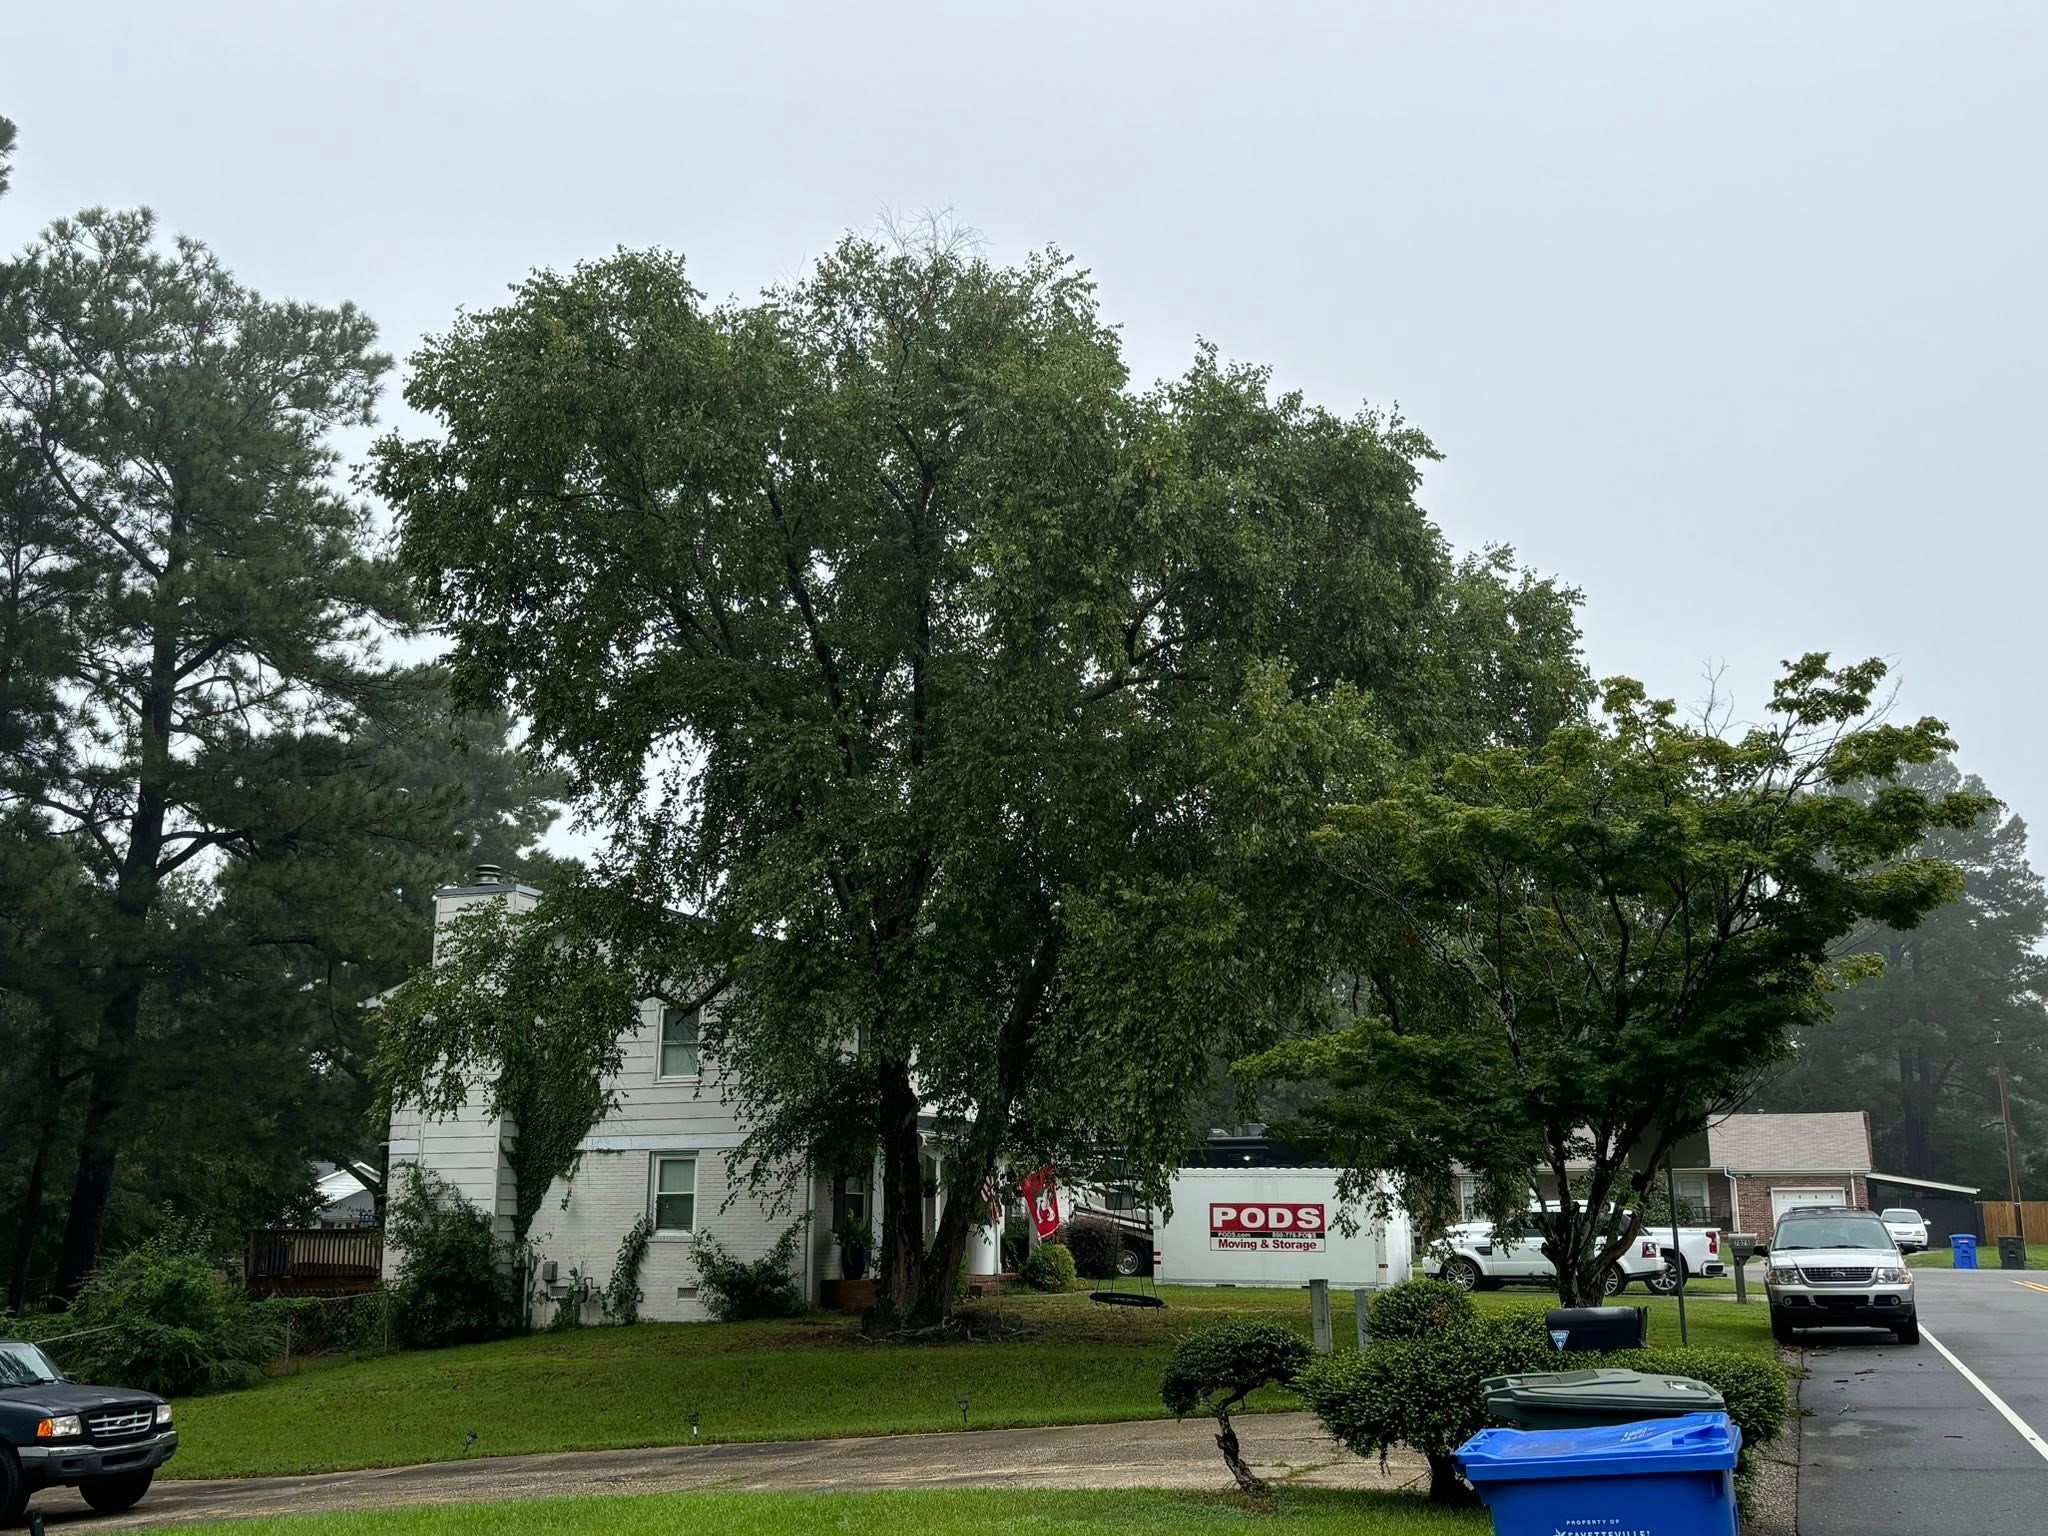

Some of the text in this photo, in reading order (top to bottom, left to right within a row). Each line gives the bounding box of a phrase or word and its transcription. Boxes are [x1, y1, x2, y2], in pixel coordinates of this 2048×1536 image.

[1213, 1207, 1321, 1229] PODS
[1218, 1239, 1317, 1251] Moving & Storage
